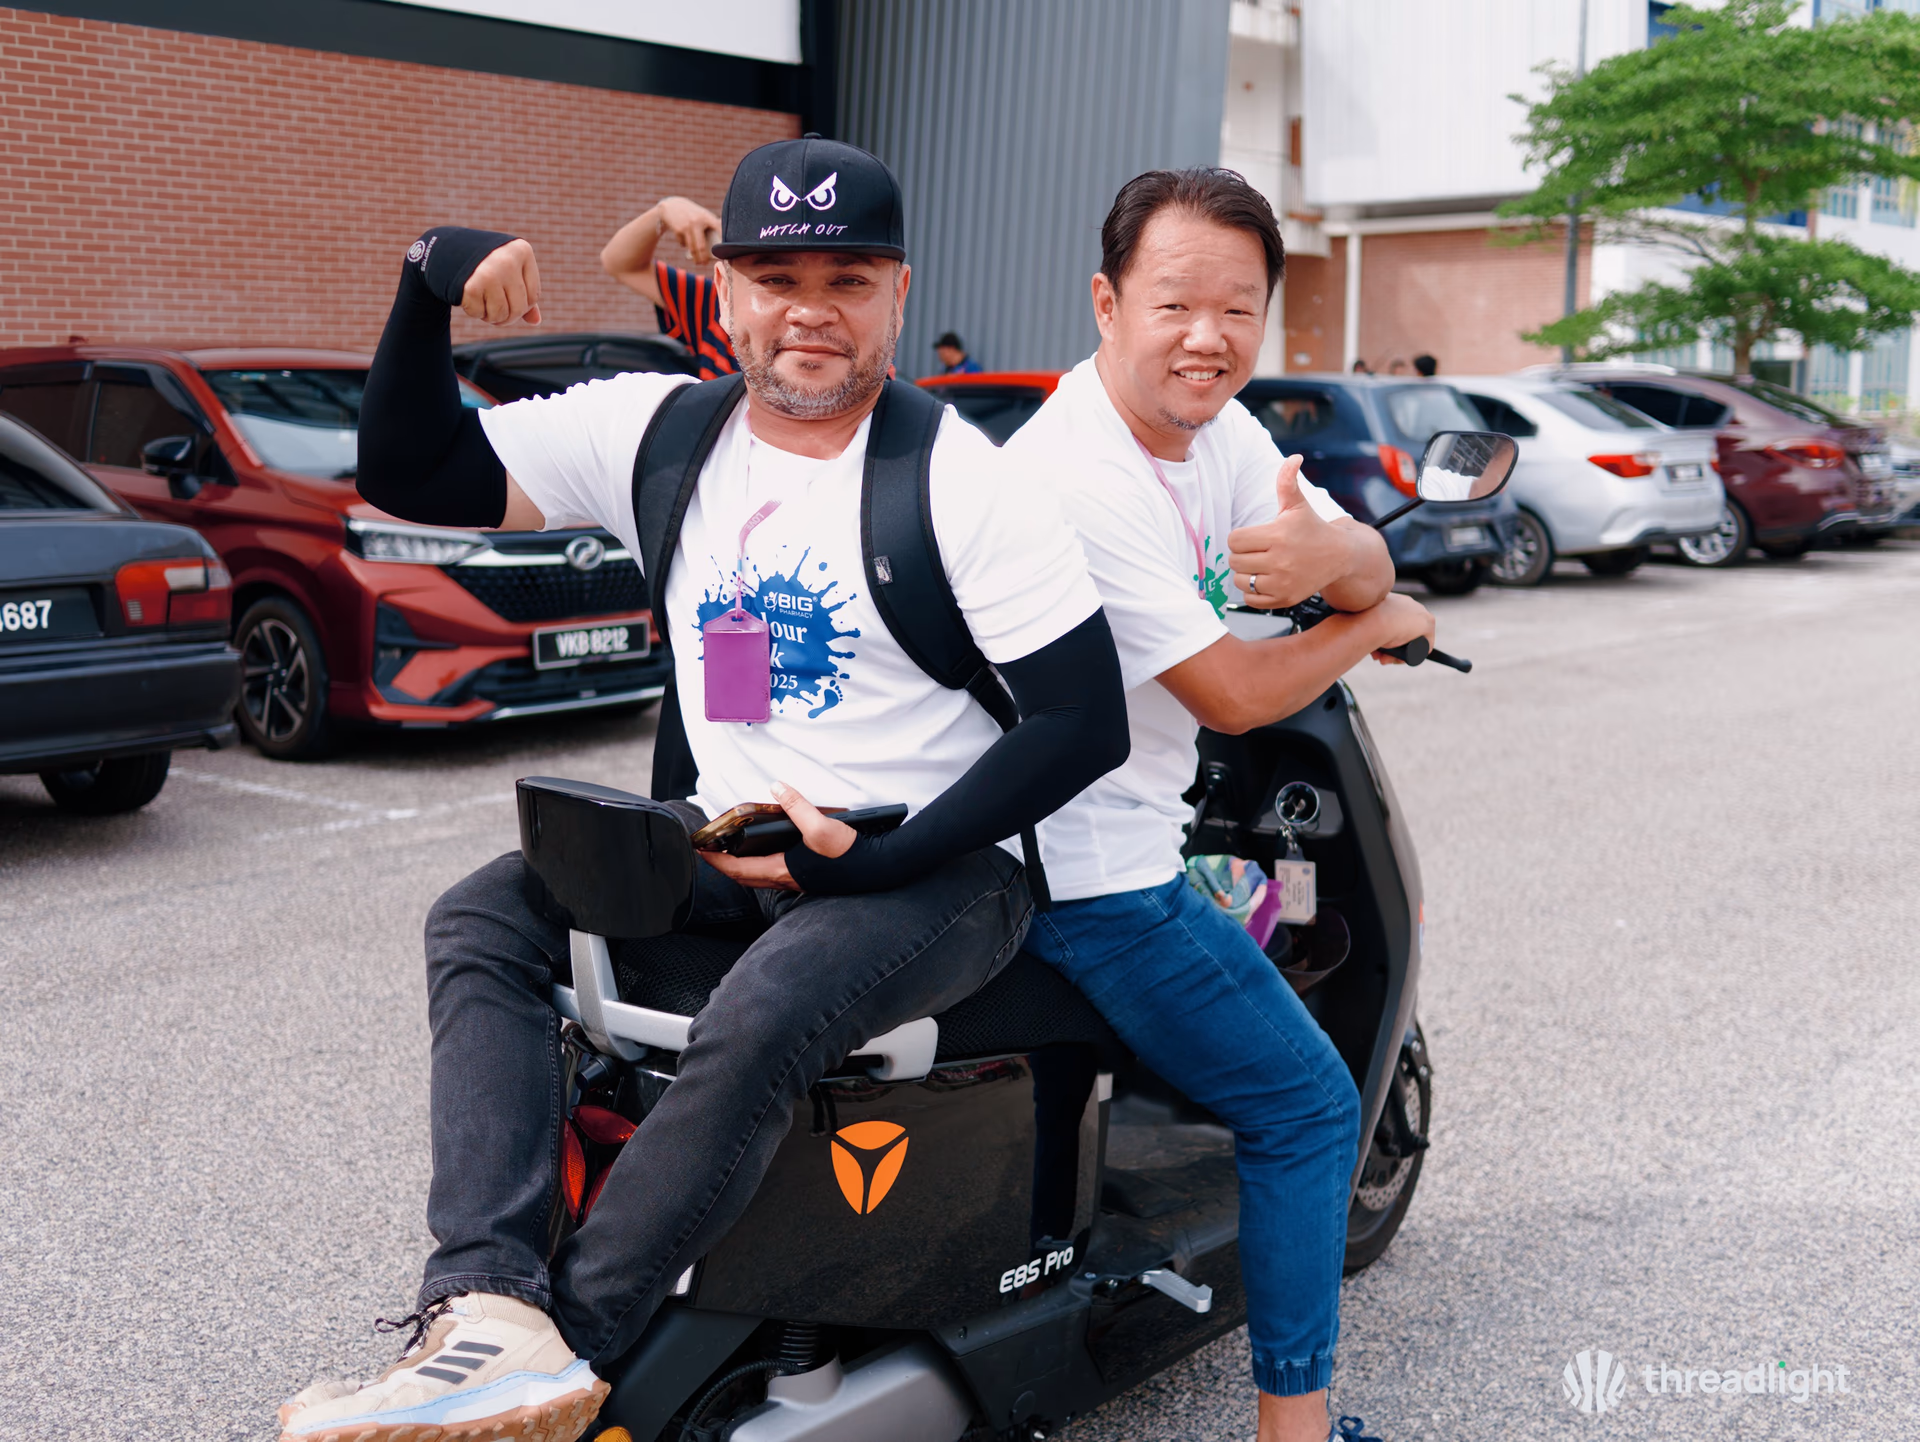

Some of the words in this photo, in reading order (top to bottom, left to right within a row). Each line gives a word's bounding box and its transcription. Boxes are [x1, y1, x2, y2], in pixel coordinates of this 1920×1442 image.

[759, 222, 811, 239] WATCH
[815, 223, 848, 236] OUT
[745, 511, 765, 529] LOVE
[778, 593, 813, 611] BIG
[0, 599, 52, 632] 687
[779, 608, 814, 619] PHARMACY
[769, 673, 798, 690] 025
[1044, 1246, 1074, 1276] Pro
